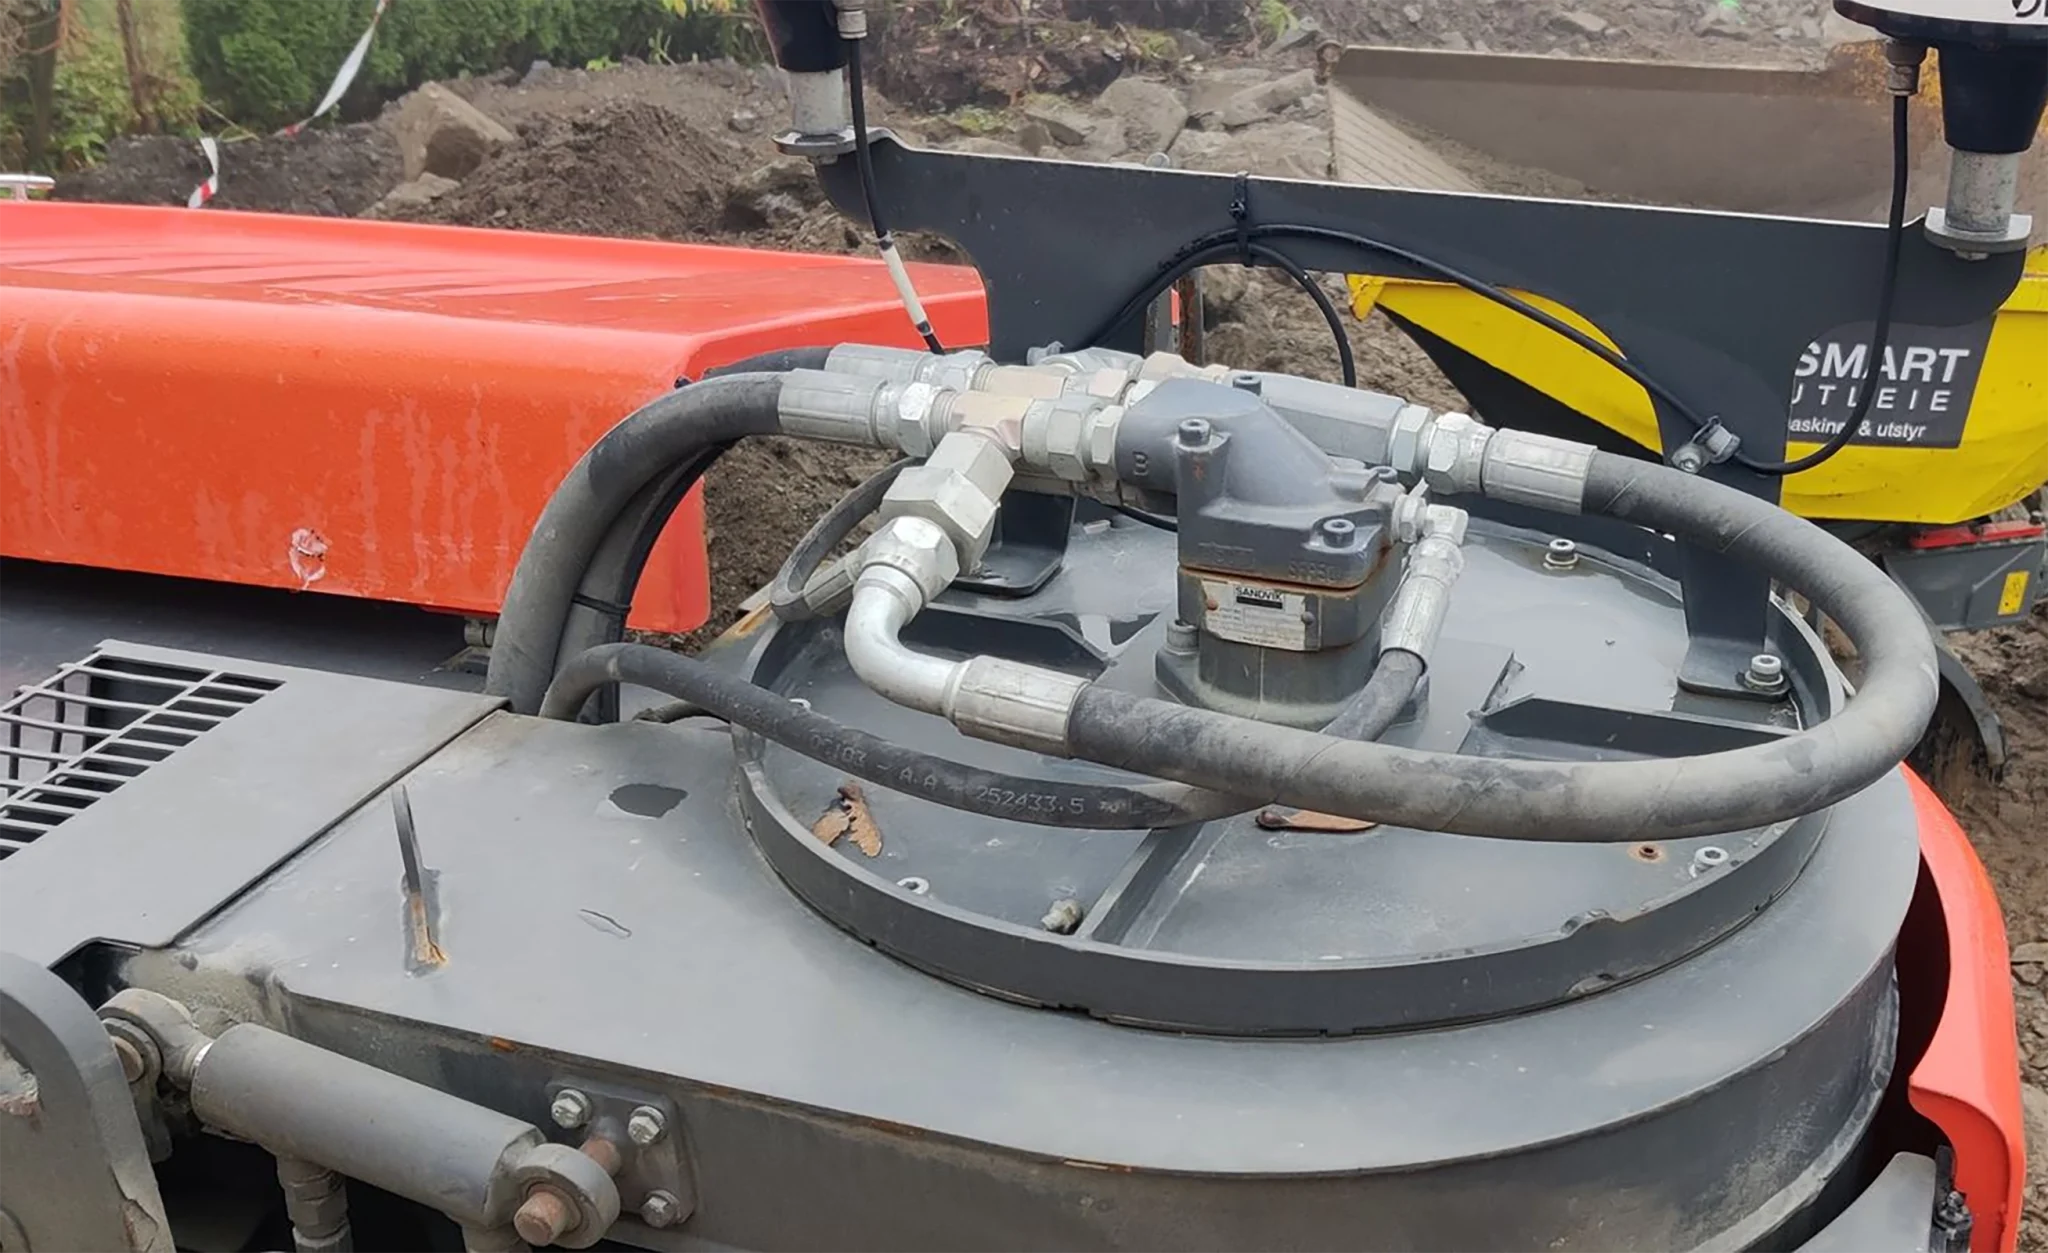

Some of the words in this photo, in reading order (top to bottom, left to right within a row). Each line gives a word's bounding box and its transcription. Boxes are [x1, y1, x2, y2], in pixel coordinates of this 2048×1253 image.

[1794, 341, 1970, 382] SMART
[1858, 420, 1871, 436] &
[1877, 422, 1927, 441] utstyr
[1132, 450, 1149, 476] B
[1236, 586, 1284, 601] SANDVIK
[977, 786, 1085, 815] 252433.5
